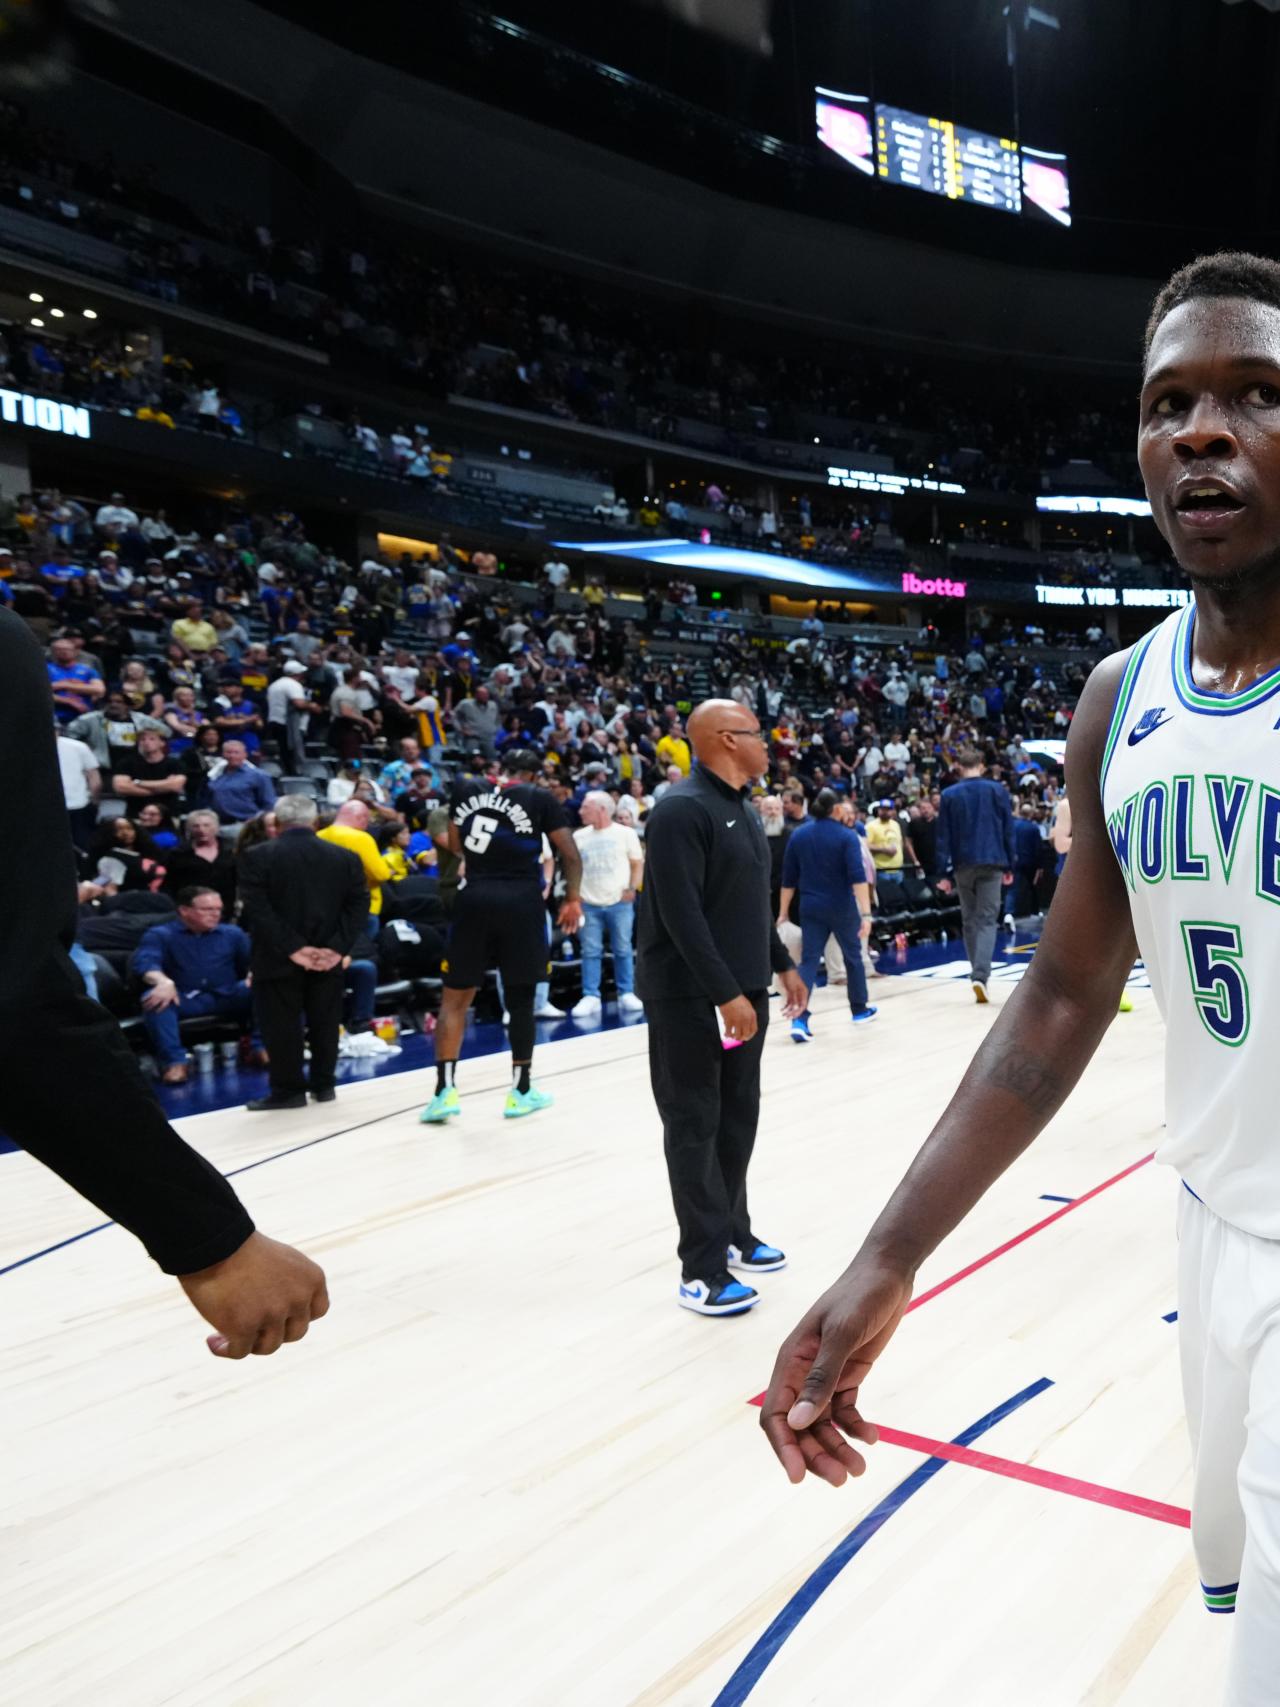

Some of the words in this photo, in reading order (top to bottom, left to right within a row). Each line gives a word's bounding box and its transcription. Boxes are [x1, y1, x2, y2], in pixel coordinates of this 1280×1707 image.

[902, 573, 966, 598] ibotta
[464, 814, 498, 854] 5
[1180, 920, 1250, 1047] 5
